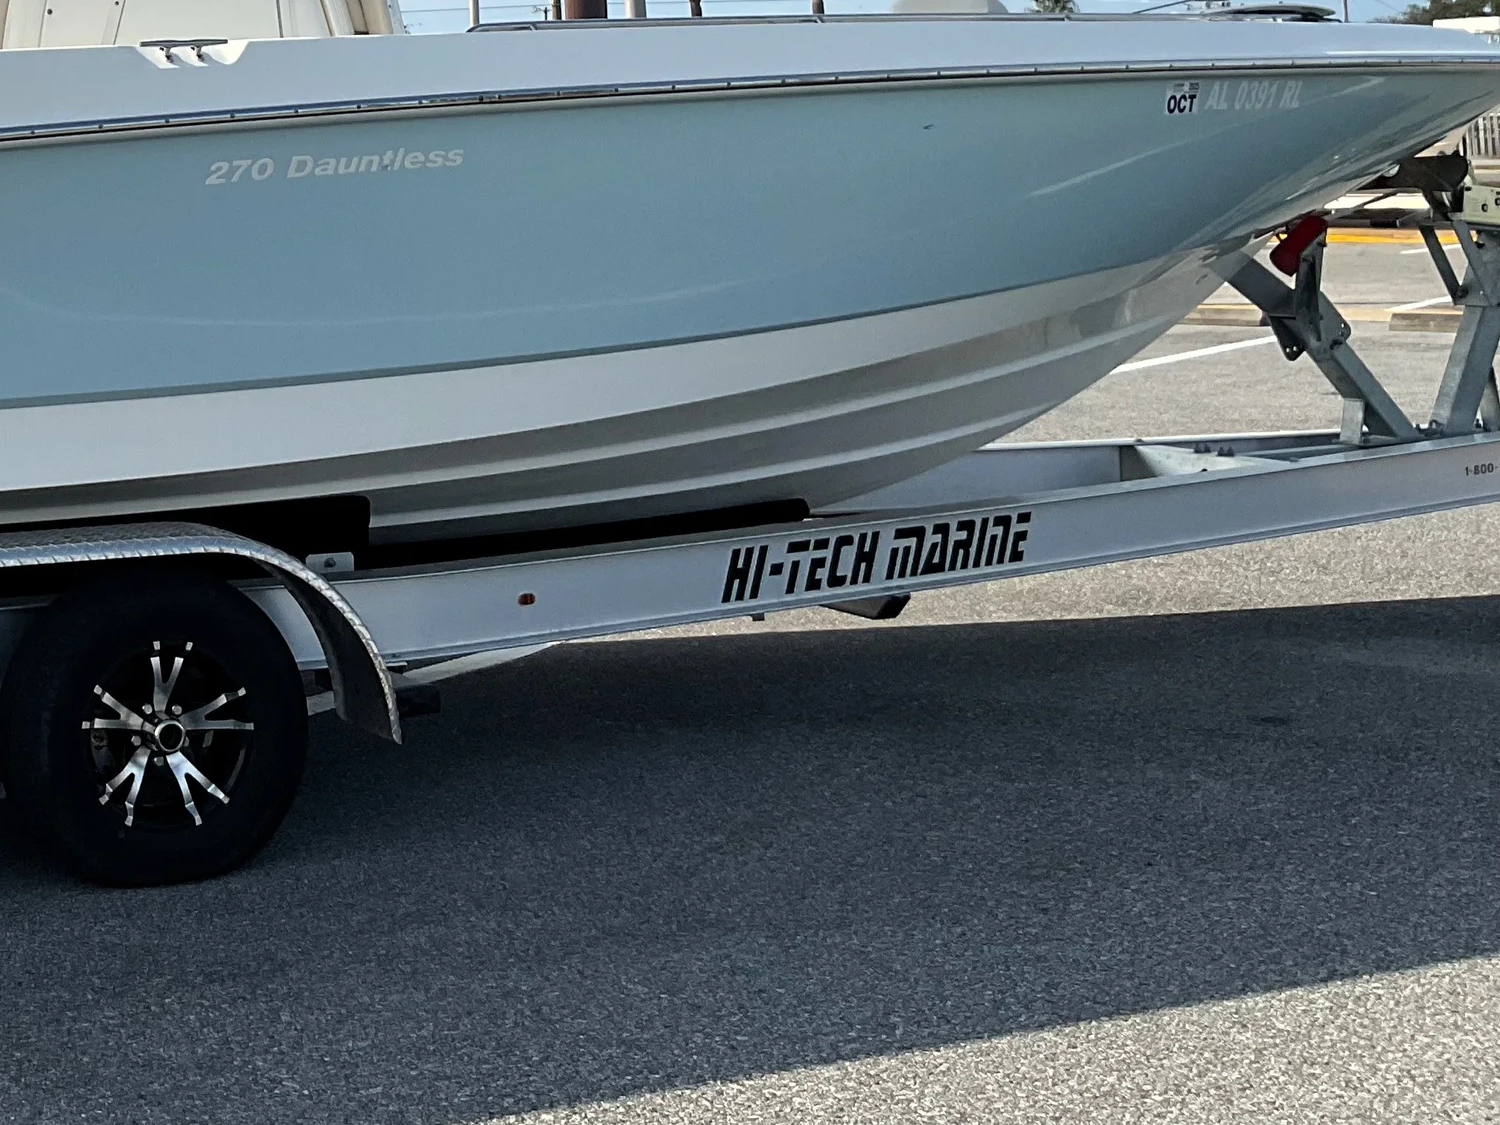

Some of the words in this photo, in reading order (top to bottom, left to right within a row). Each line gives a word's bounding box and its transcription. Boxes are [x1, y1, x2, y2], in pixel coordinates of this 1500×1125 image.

[1167, 94, 1197, 114] OCT
[1204, 80, 1230, 110] AL
[205, 157, 275, 185] 270
[286, 148, 464, 179] Dauntless
[721, 530, 880, 603] HI-TECH
